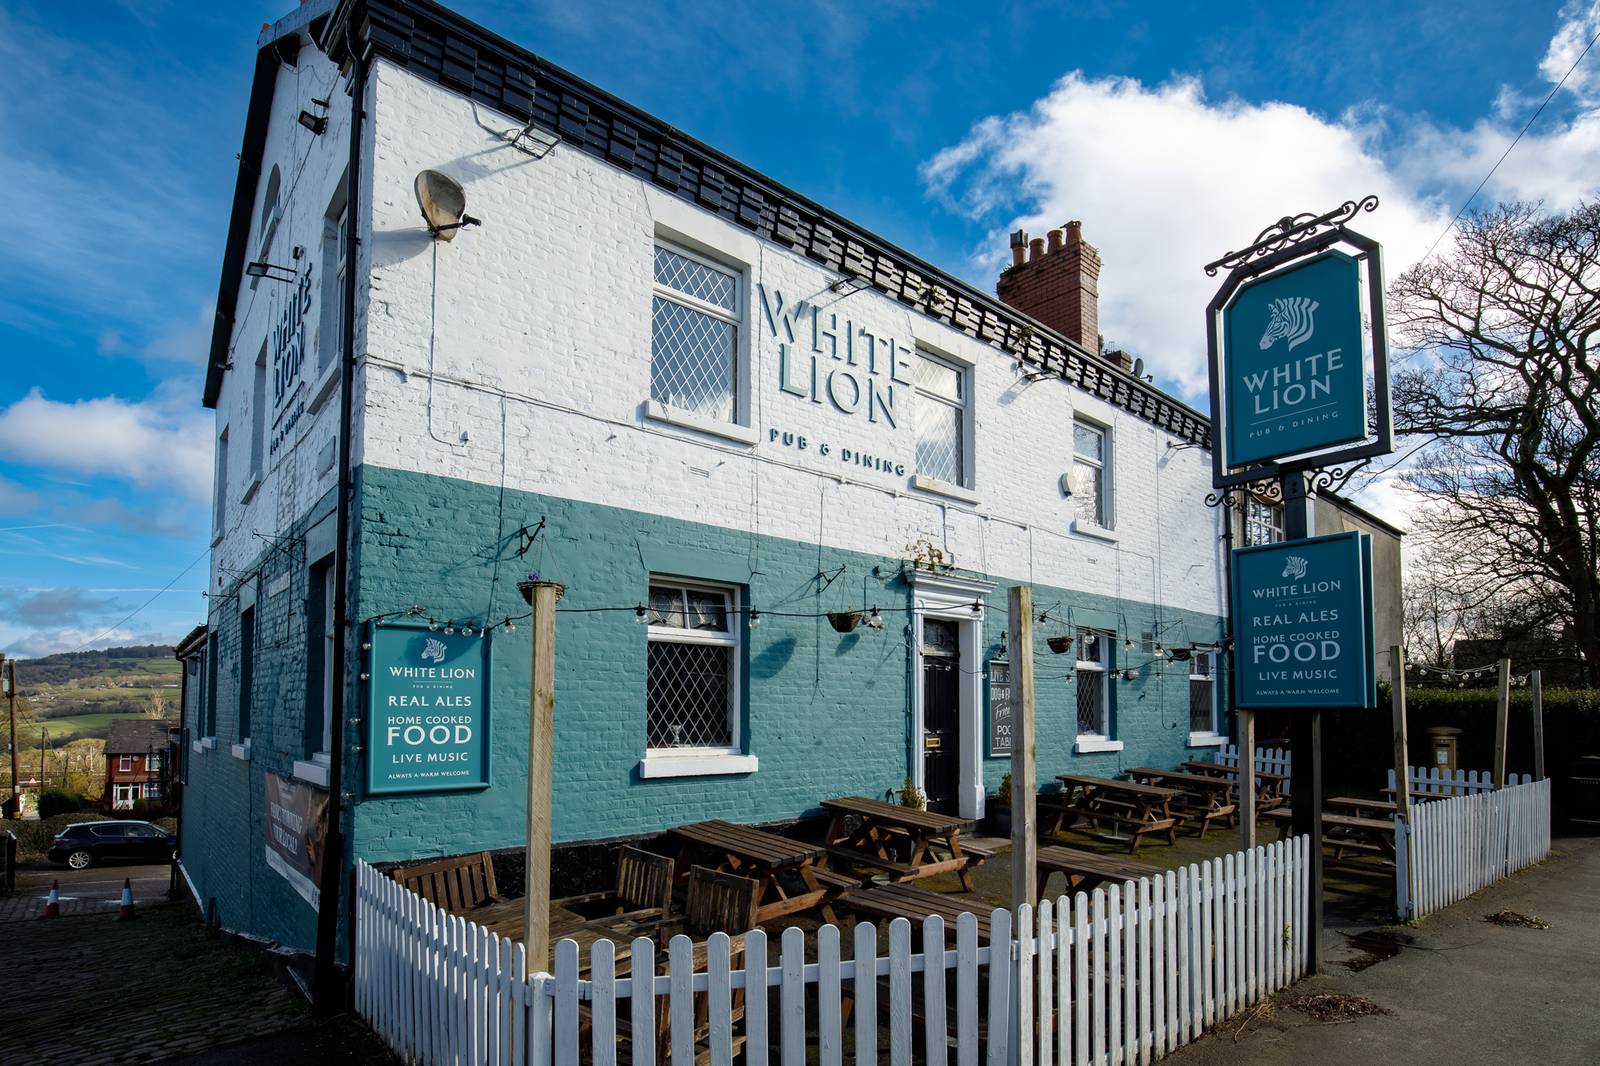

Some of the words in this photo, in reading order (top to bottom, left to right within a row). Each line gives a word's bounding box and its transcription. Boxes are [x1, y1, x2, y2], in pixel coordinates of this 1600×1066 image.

[273, 262, 312, 367] WHITE
[757, 283, 914, 386] WHITE
[275, 321, 305, 408] LION
[1242, 348, 1344, 394] WHITE
[779, 343, 897, 429] LION
[1254, 375, 1331, 415] LION
[1249, 428, 1271, 438] PUB
[1278, 424, 1285, 432] &
[1292, 411, 1339, 428] DINING
[769, 428, 807, 450] PUB
[820, 443, 830, 456] &
[842, 448, 905, 476] DINING
[1252, 584, 1298, 599] WHITE
[1303, 579, 1341, 594] LION
[1253, 614, 1293, 627] REAL
[1298, 609, 1339, 623] ALES
[1253, 634, 1286, 644] HOME
[1289, 631, 1340, 642] COOKED
[1253, 640, 1341, 664] FOOD
[389, 666, 436, 678] WHITE
[441, 668, 475, 679] LION
[1259, 671, 1288, 681] LIVE
[1292, 669, 1337, 680] MUSIC
[388, 696, 429, 707] REAL
[435, 696, 472, 707] ALES
[388, 716, 421, 725] HOME
[425, 716, 472, 724] COOKED
[387, 725, 473, 746] FOOD
[392, 754, 422, 764] LIVE
[427, 752, 468, 763] MUSIC
